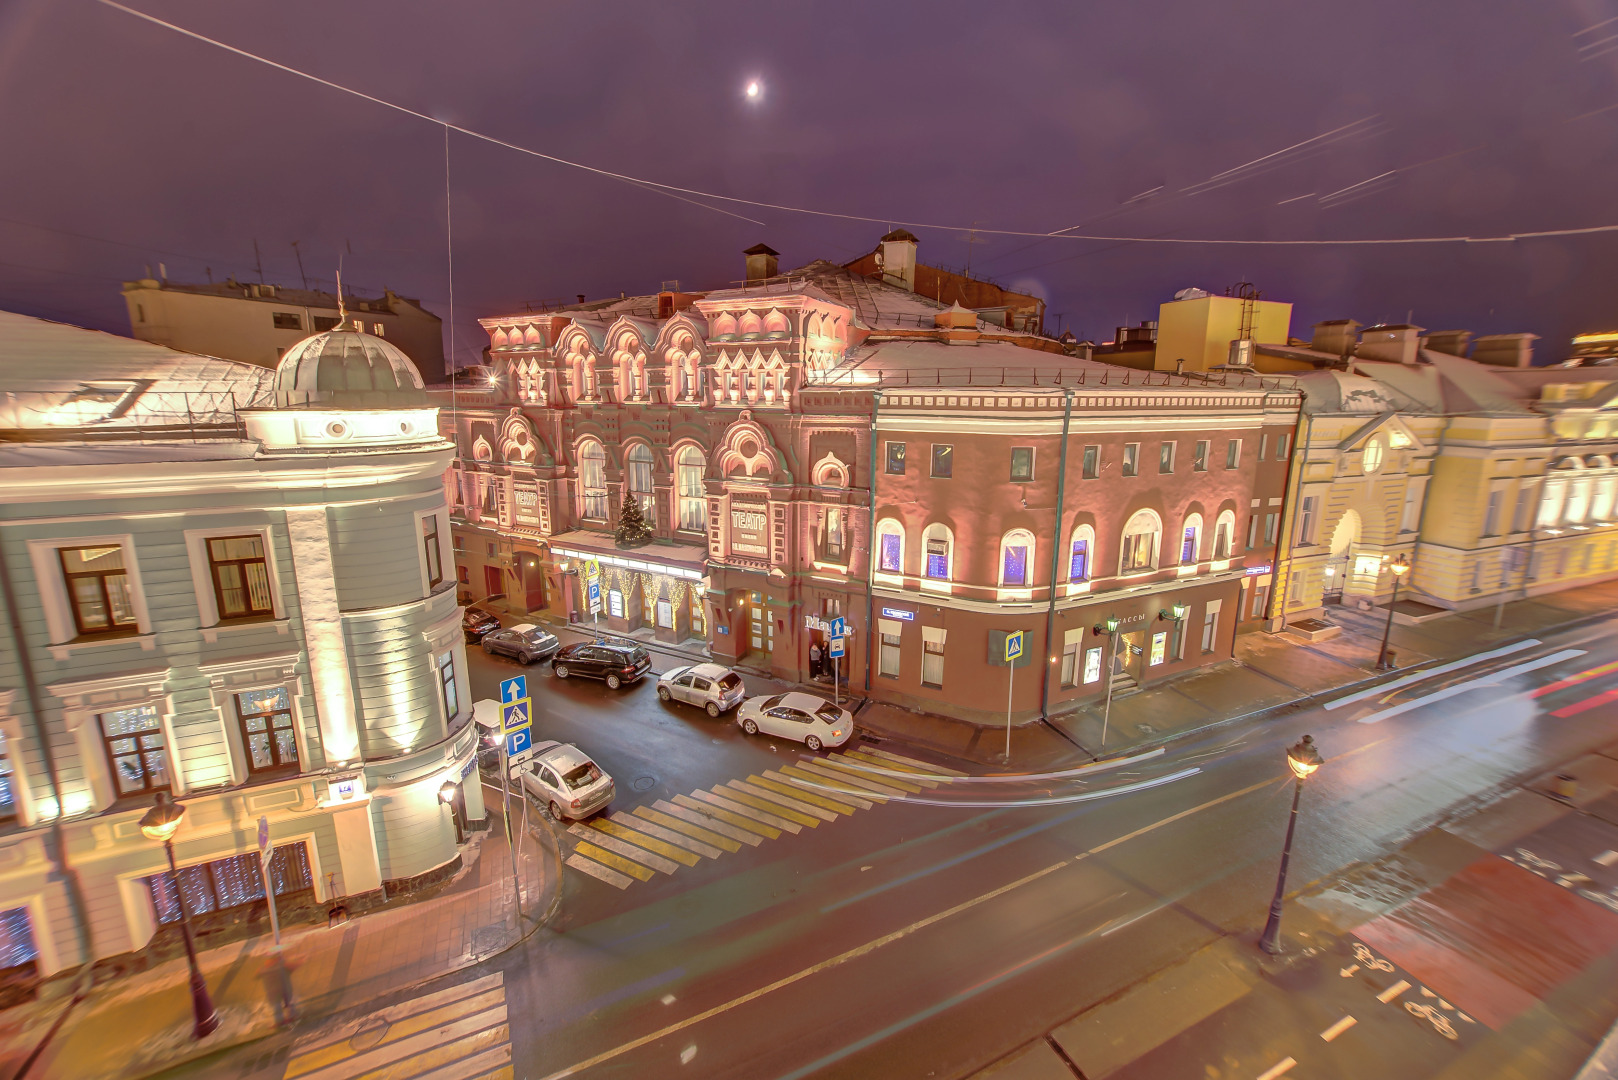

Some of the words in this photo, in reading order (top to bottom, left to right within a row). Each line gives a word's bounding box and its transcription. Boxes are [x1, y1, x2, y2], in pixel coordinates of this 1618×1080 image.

[514, 490, 538, 506] ТЕАТР
[731, 511, 767, 531] ТЕАТР
[591, 586, 598, 598] P
[804, 615, 852, 636] Мак
[513, 732, 526, 752] P
